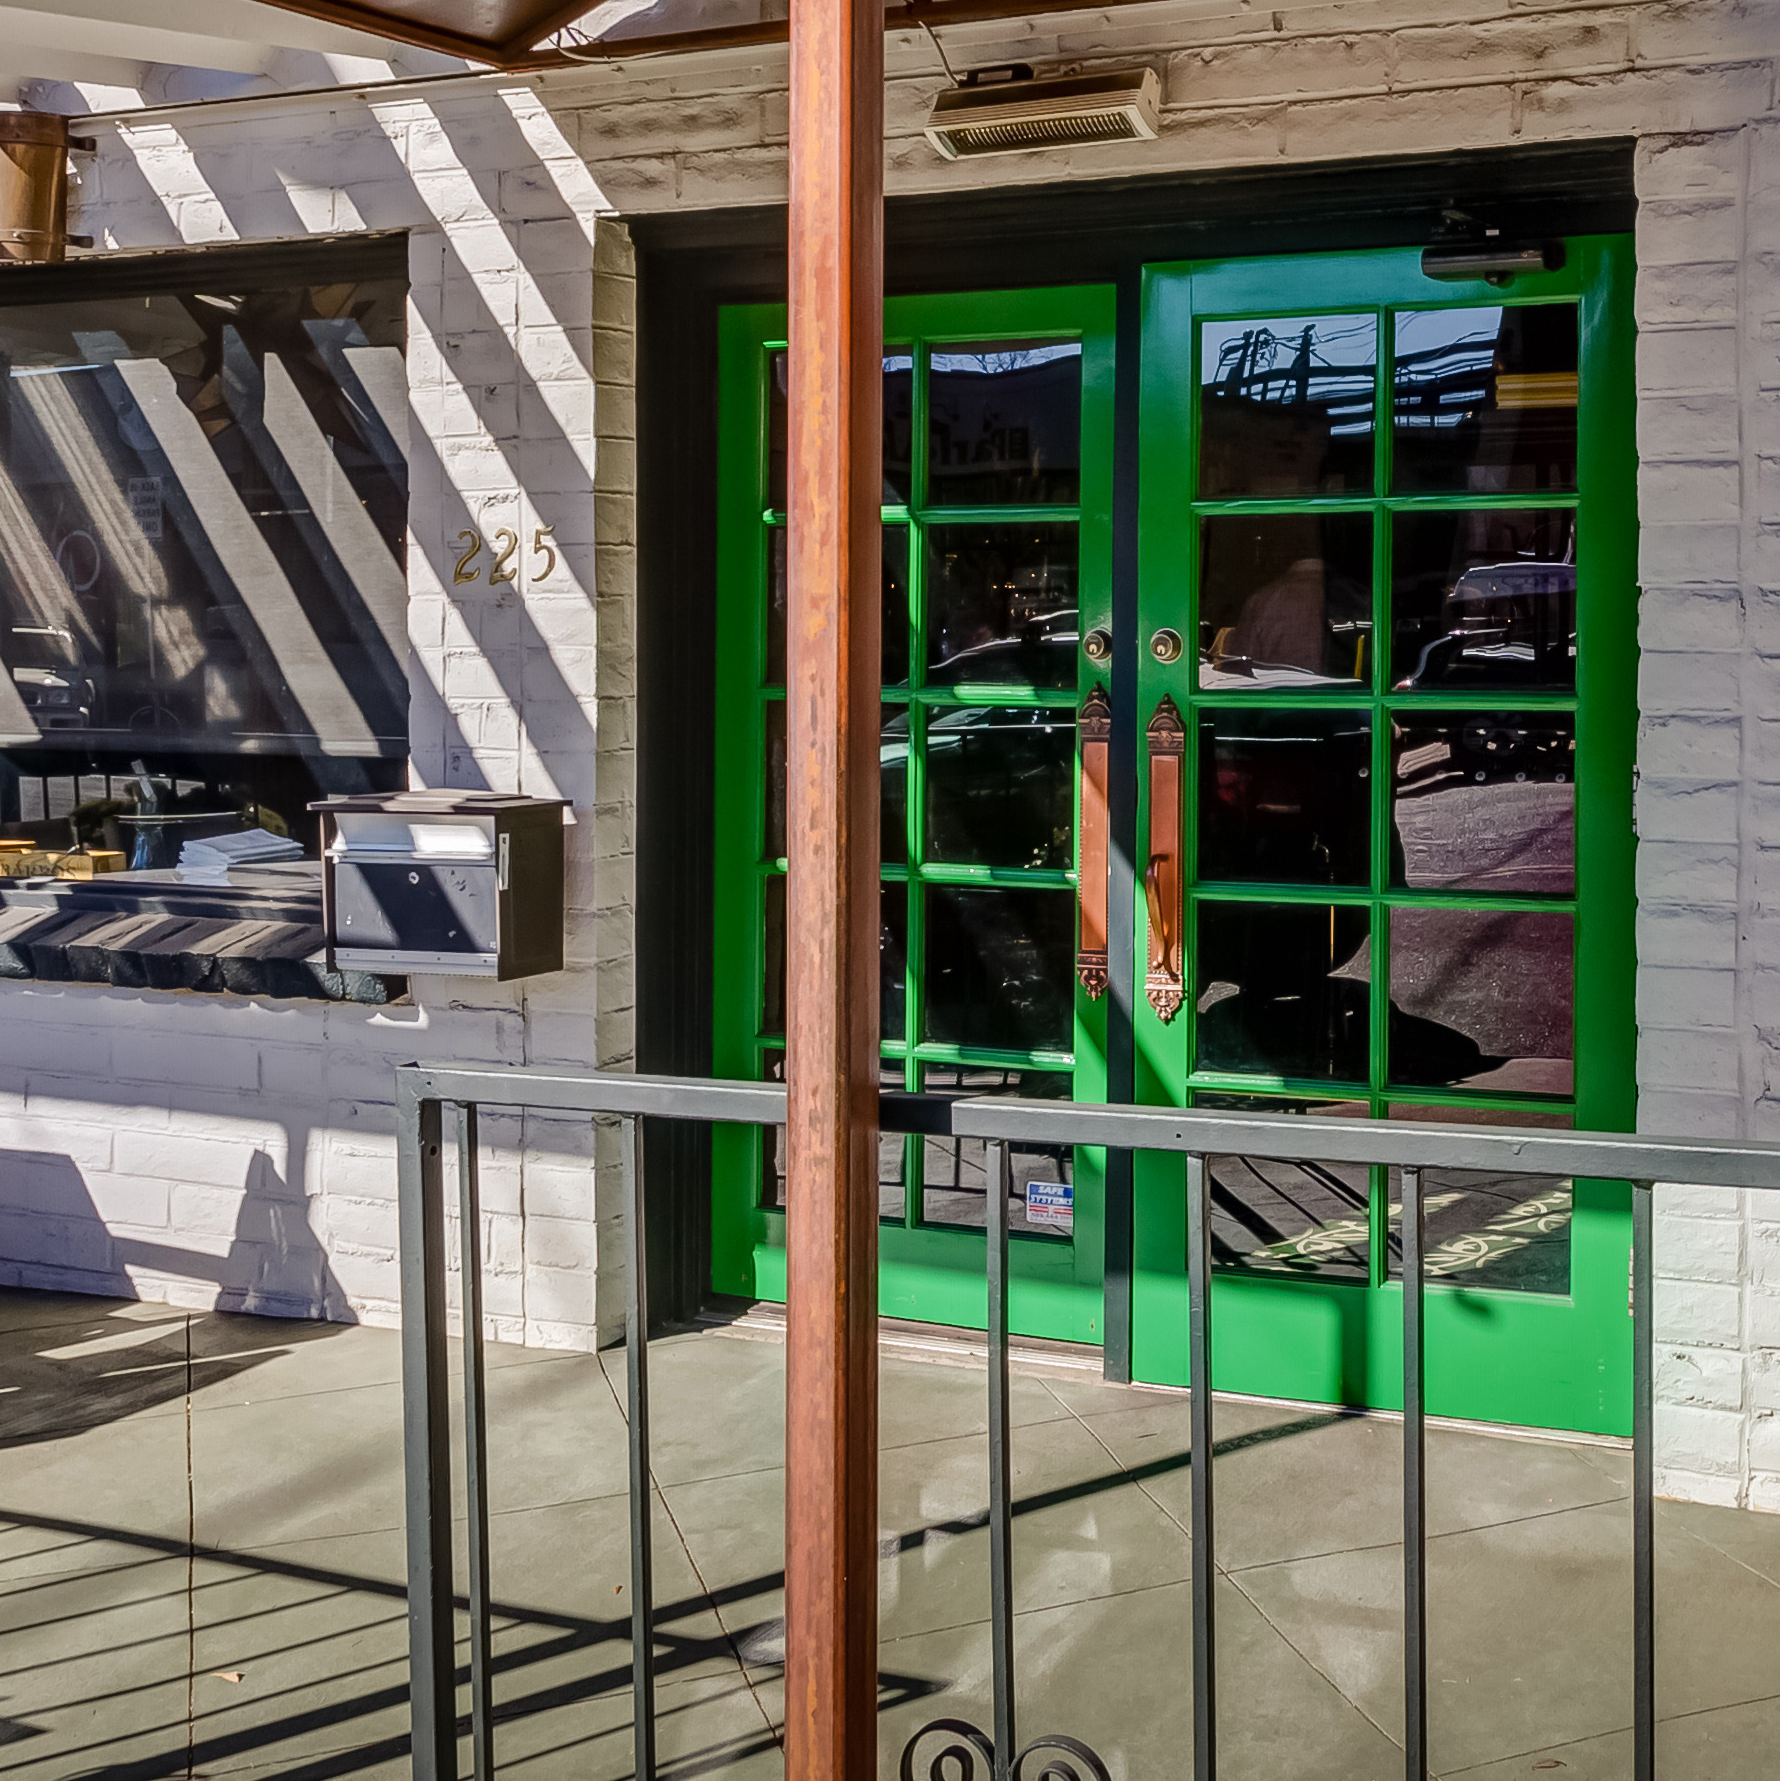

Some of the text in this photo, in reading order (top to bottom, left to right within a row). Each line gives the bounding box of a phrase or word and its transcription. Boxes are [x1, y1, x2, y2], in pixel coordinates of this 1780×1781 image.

[454, 525, 556, 585] 225
[1038, 1185, 1065, 1196] SAFE
[1030, 1194, 1073, 1206] SYSTEMS
